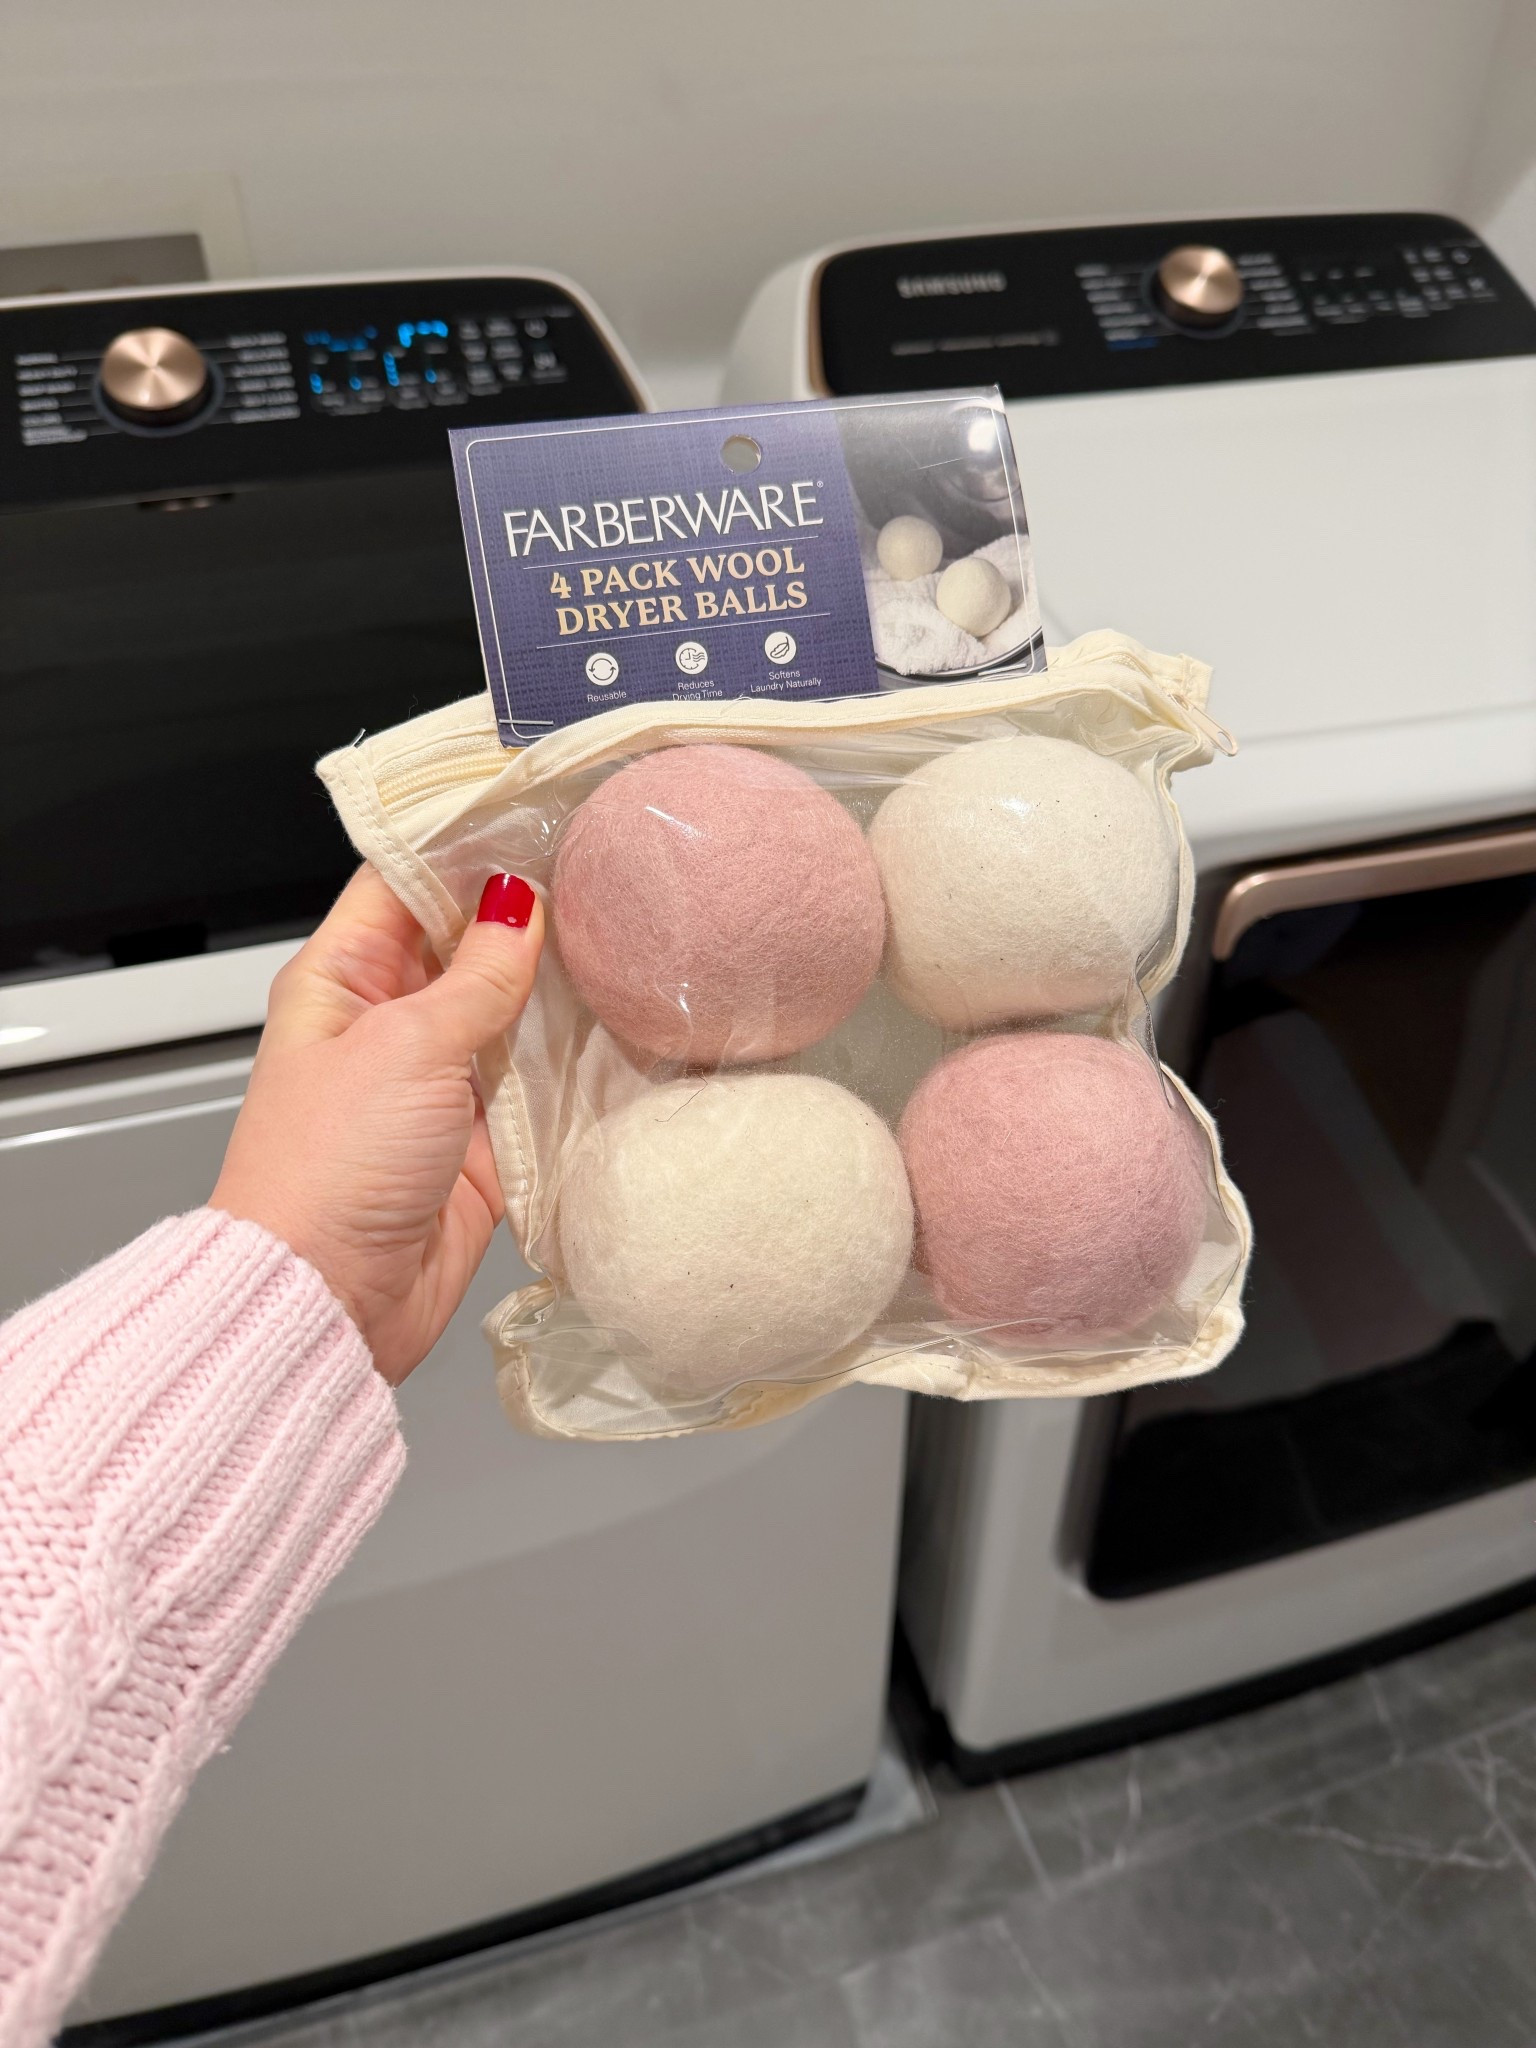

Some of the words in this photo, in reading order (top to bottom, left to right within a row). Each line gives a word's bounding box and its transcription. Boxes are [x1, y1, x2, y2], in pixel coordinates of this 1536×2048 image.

[550, 572, 572, 599] 4
[580, 560, 682, 597] PACK
[686, 547, 806, 584] WOOL
[556, 595, 688, 636] DRYER
[695, 581, 808, 620] BALLS
[768, 669, 801, 681] Softens
[677, 680, 715, 691] Reduces
[750, 682, 785, 694] Laundry
[786, 676, 822, 689] Naturally
[586, 690, 627, 703] Reusable
[701, 689, 723, 699] Time
